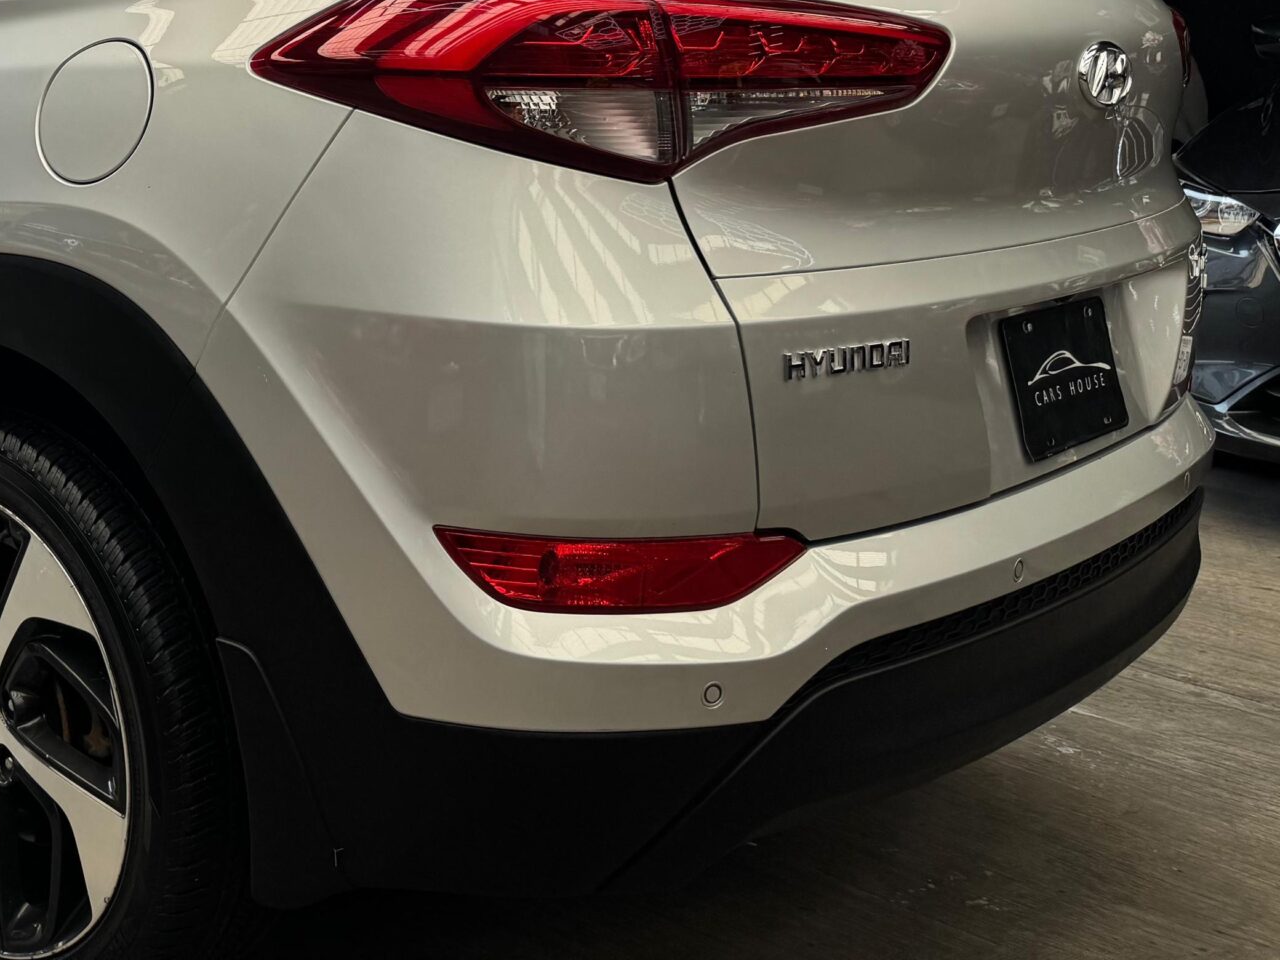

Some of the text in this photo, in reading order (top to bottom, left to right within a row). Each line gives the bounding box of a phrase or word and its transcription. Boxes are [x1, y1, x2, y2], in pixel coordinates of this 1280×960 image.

[783, 338, 910, 381] HYUNDAI
[1034, 372, 1107, 406] CARS HOUSE
